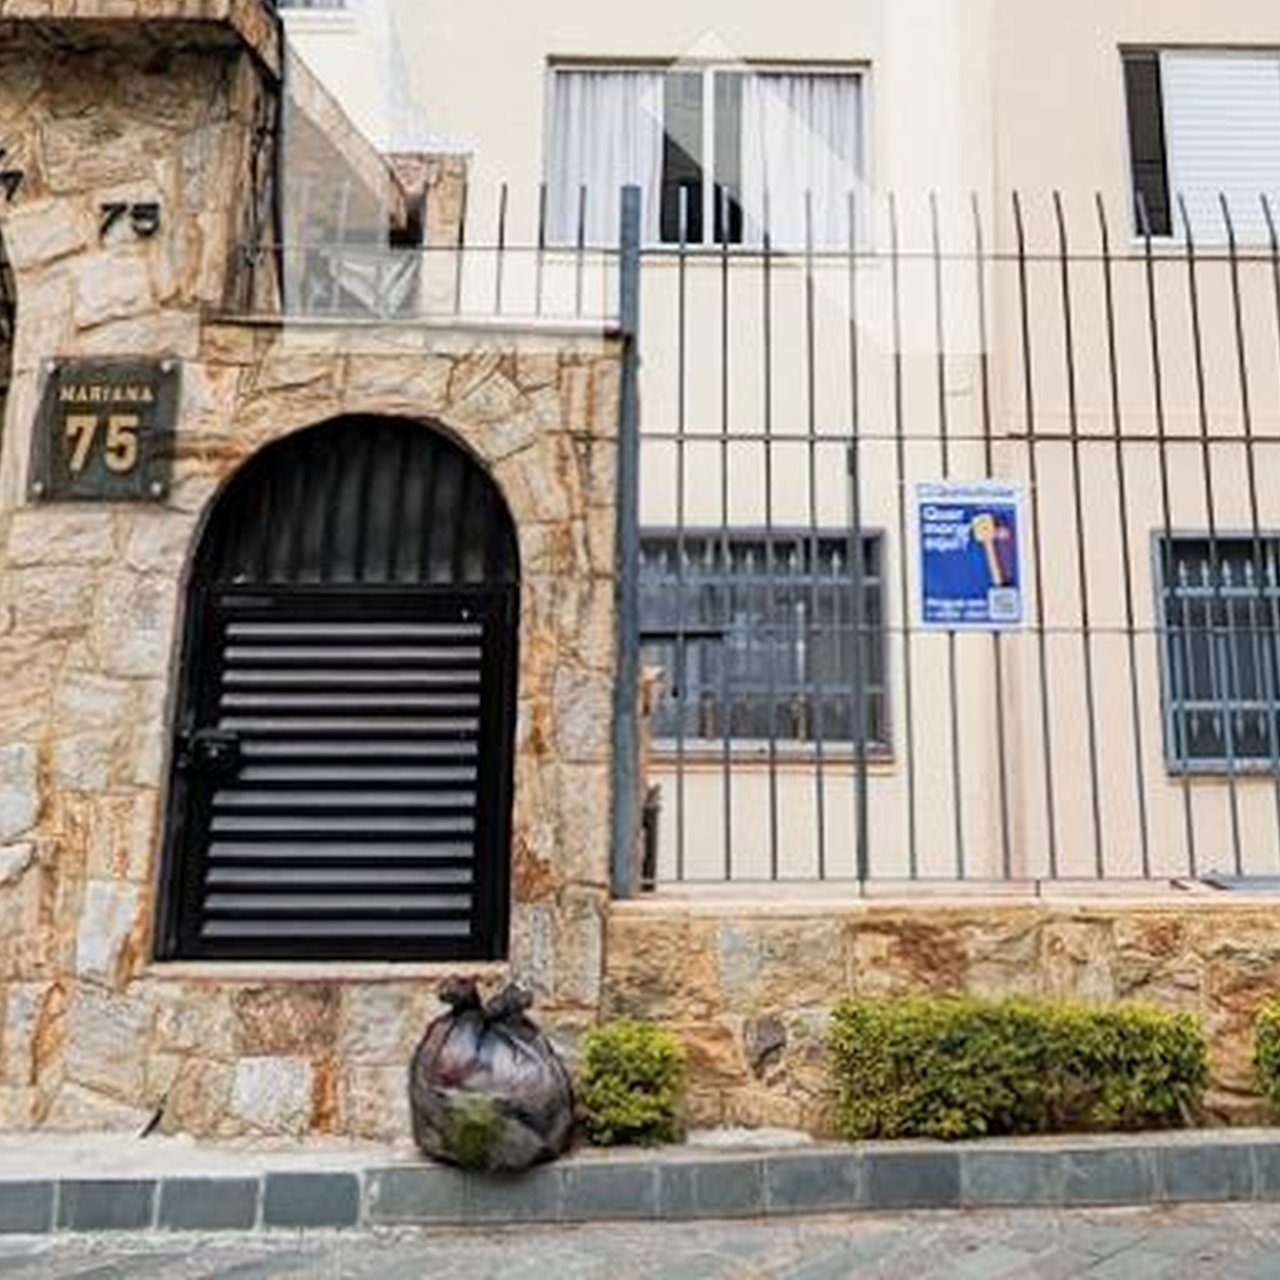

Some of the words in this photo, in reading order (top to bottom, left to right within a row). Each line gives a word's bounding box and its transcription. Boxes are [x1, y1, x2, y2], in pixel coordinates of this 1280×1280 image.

[99, 202, 160, 240] 75
[59, 385, 154, 402] MARIANA
[65, 413, 140, 472] 75
